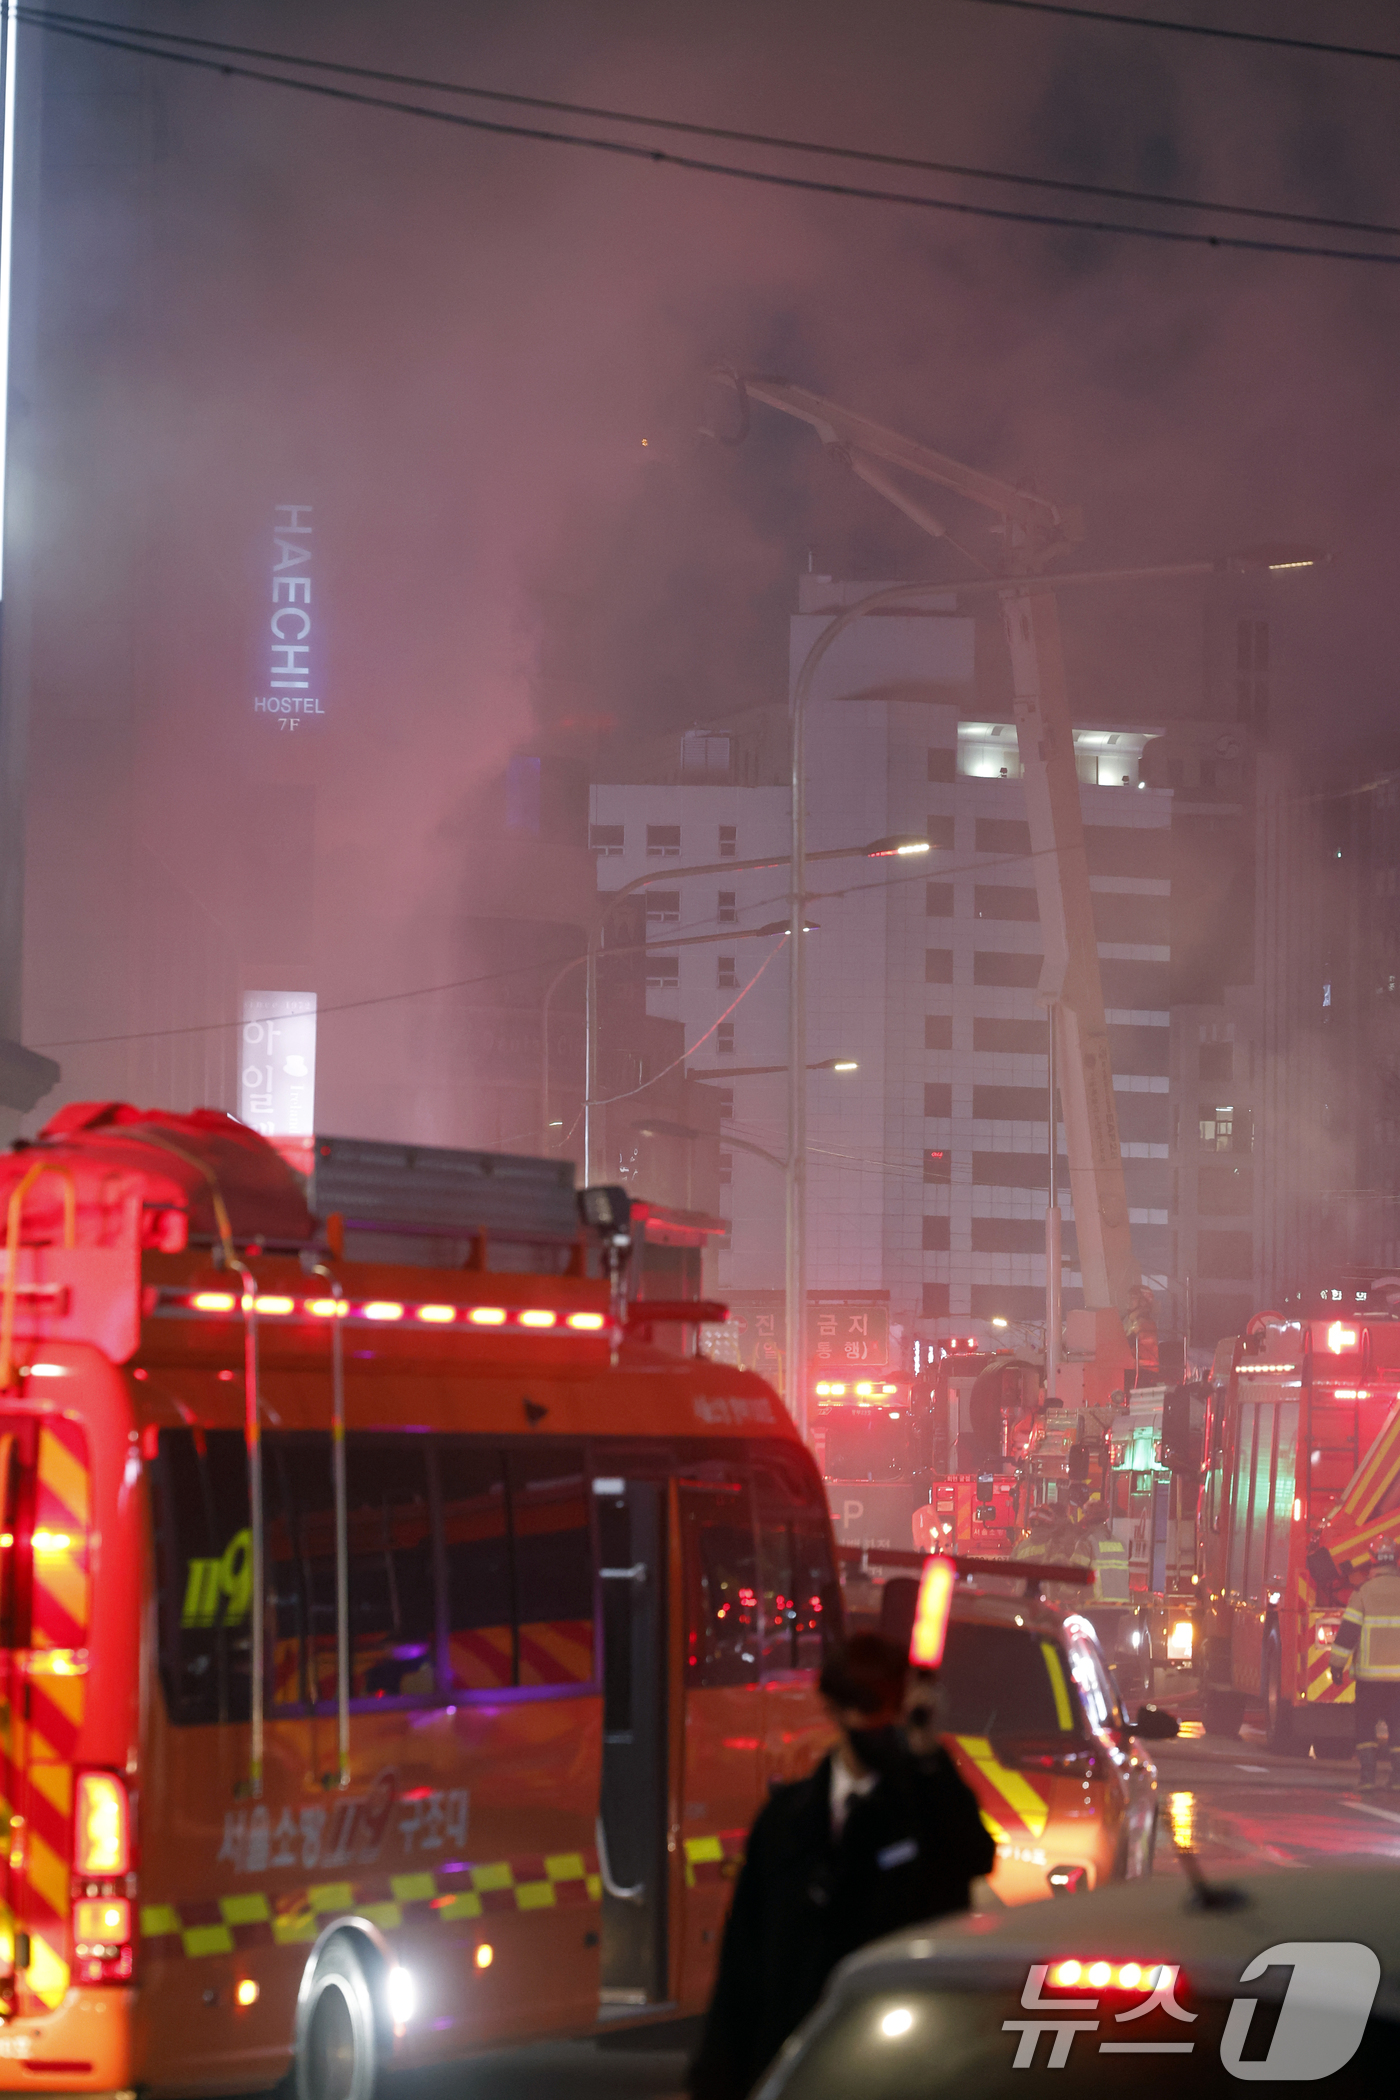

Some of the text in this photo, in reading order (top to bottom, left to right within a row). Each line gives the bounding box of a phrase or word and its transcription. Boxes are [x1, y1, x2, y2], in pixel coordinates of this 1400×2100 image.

[270, 504, 313, 689] HAECHI
[254, 697, 325, 714] HOSTEL
[278, 718, 300, 731] 7F
[181, 1527, 253, 1628] 119
